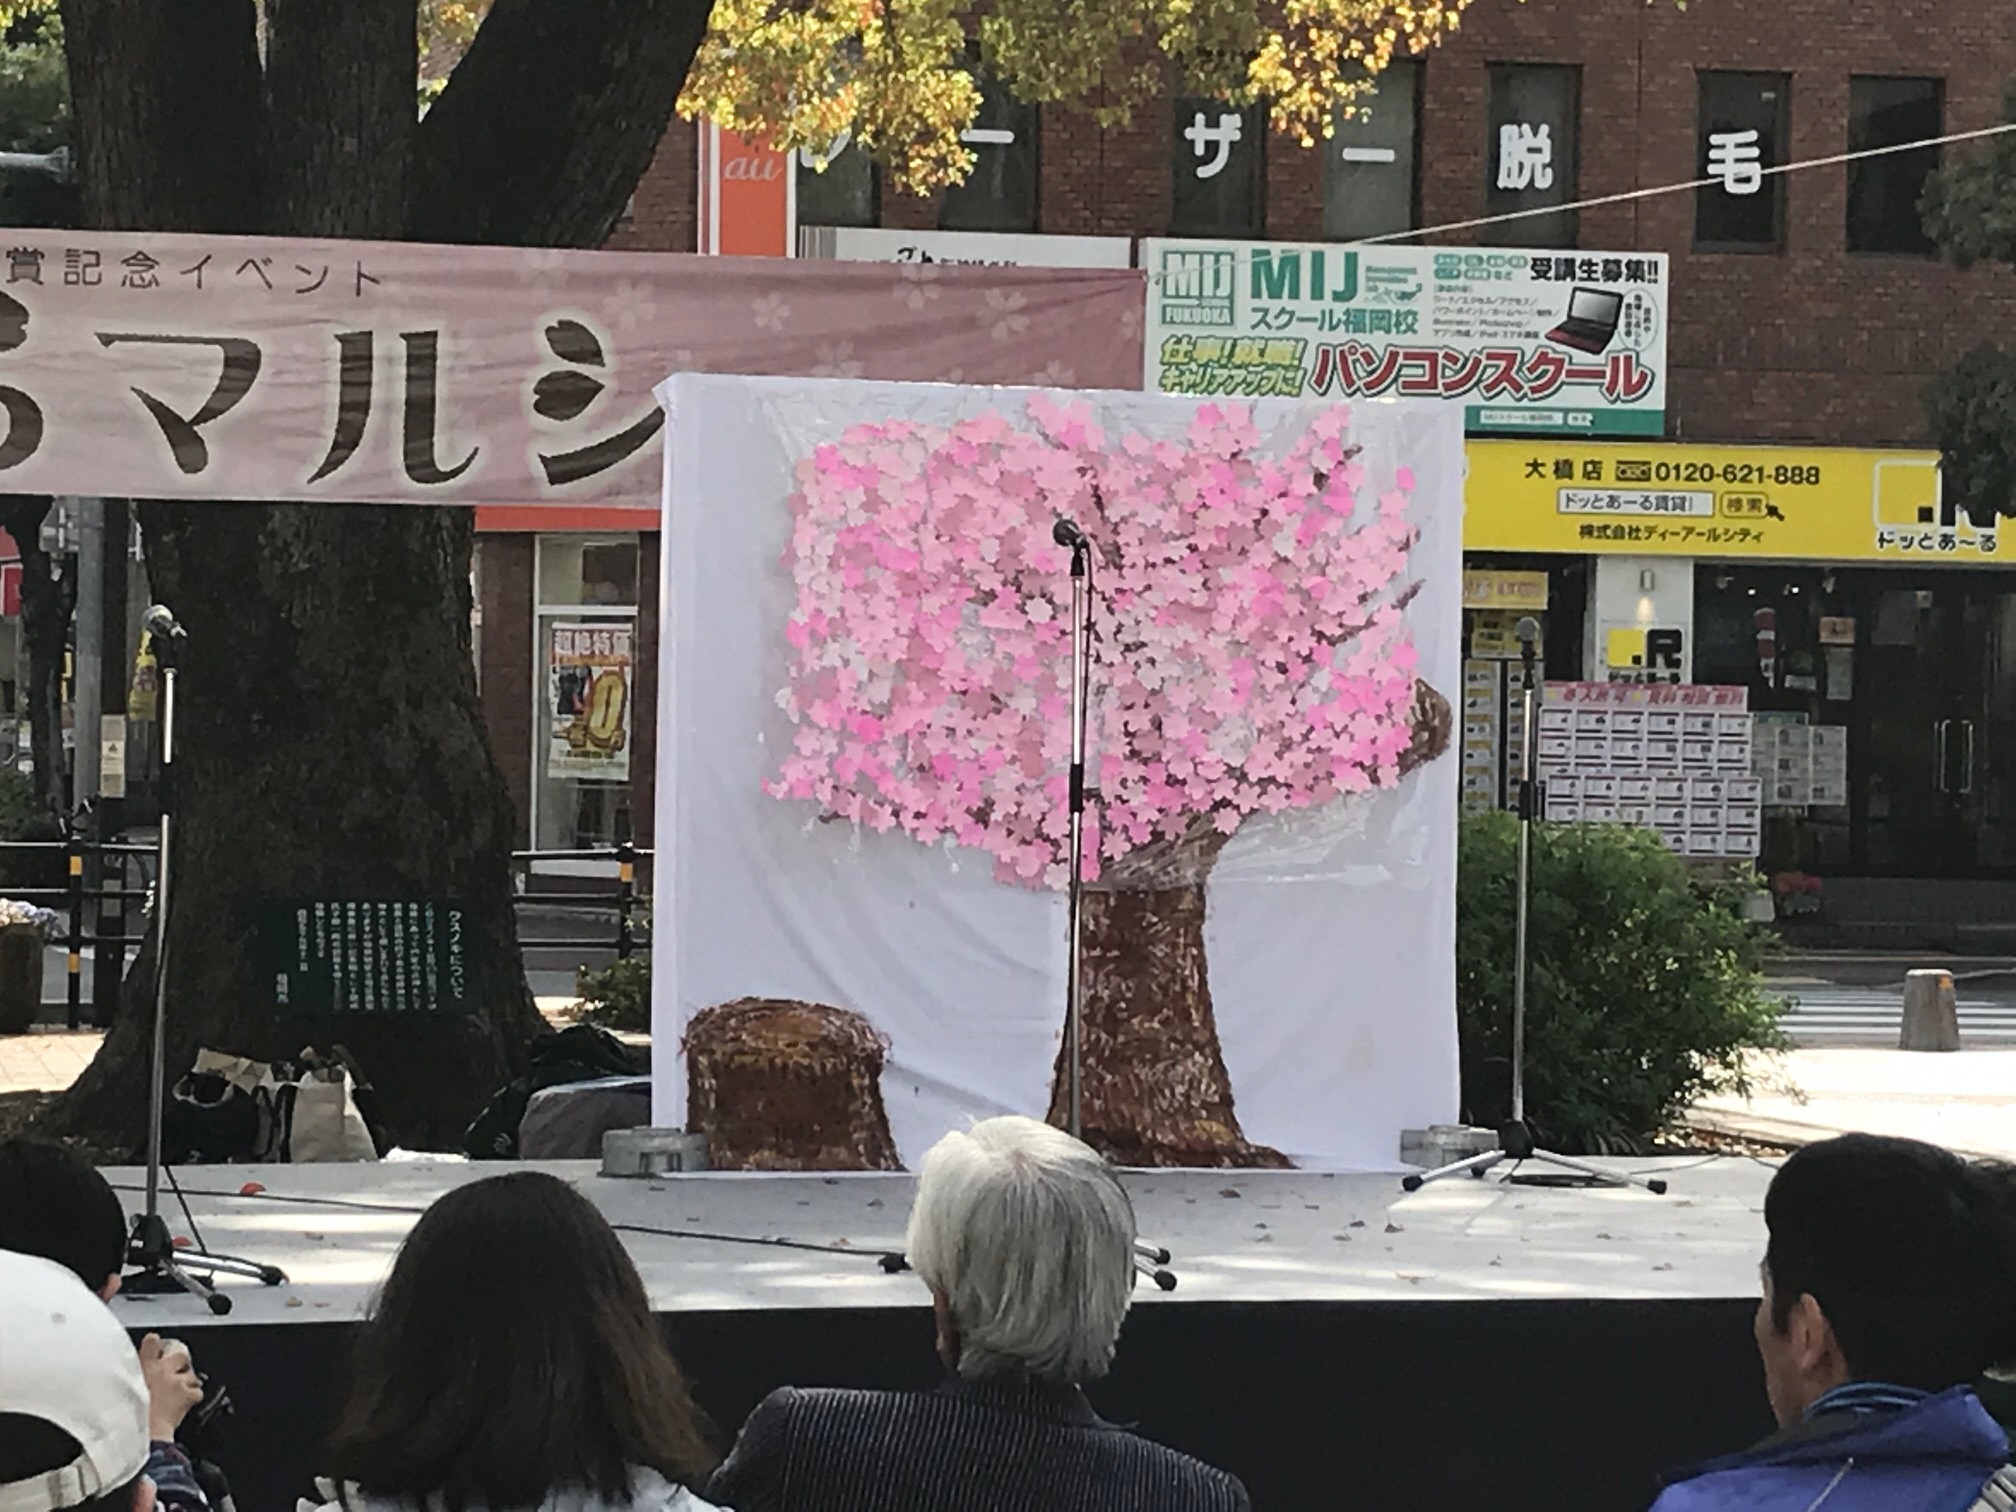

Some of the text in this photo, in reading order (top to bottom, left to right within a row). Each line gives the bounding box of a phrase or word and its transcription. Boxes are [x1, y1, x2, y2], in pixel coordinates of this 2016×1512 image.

[724, 157, 783, 180] au
[5, 247, 381, 297] 賞記念イベント
[1166, 253, 1231, 297] MIJ
[1251, 249, 1358, 302] MIJ
[1530, 256, 1659, 283] 受講生募集!!
[1166, 307, 1231, 323] FUKUOKA
[1250, 307, 1419, 335] スクール福岡校
[1310, 343, 1653, 399] パソコンスクール
[1525, 458, 1820, 485] 大橋店 0120-621-888
[1565, 493, 1687, 513] ドッとあーる賃貸
[1727, 496, 1763, 513] 検索
